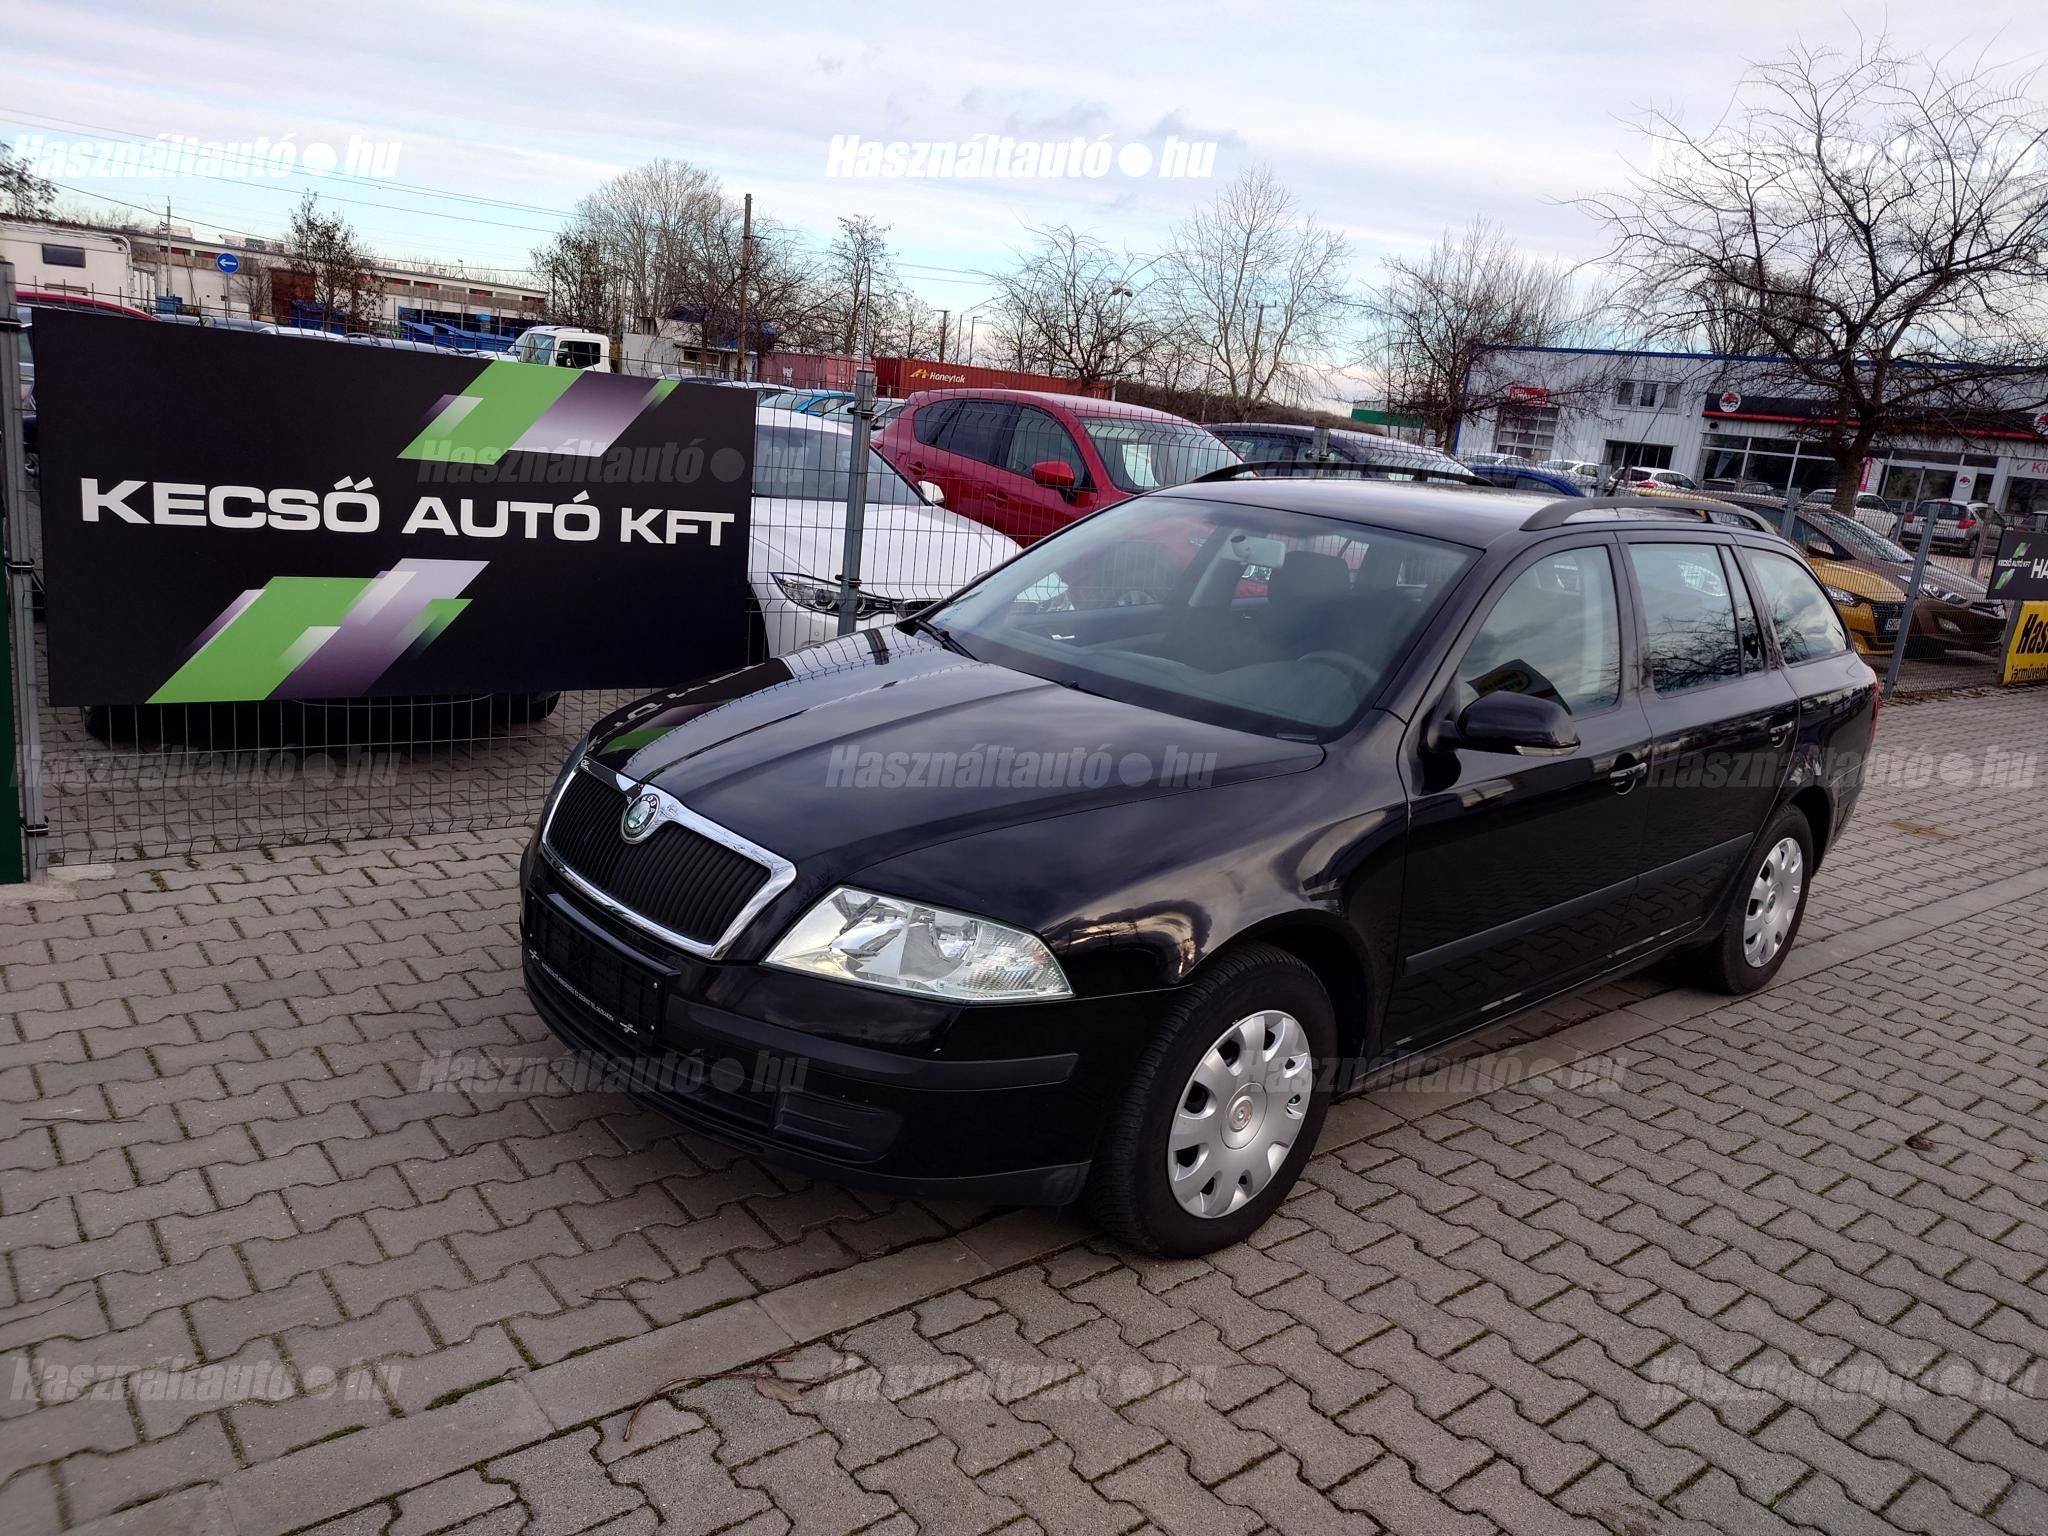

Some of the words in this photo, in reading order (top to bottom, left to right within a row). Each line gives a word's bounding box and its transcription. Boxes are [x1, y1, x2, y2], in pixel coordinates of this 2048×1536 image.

[81, 476, 379, 532] KECSŐ
[401, 490, 600, 541] AUTÓ
[620, 507, 734, 546] KFT
